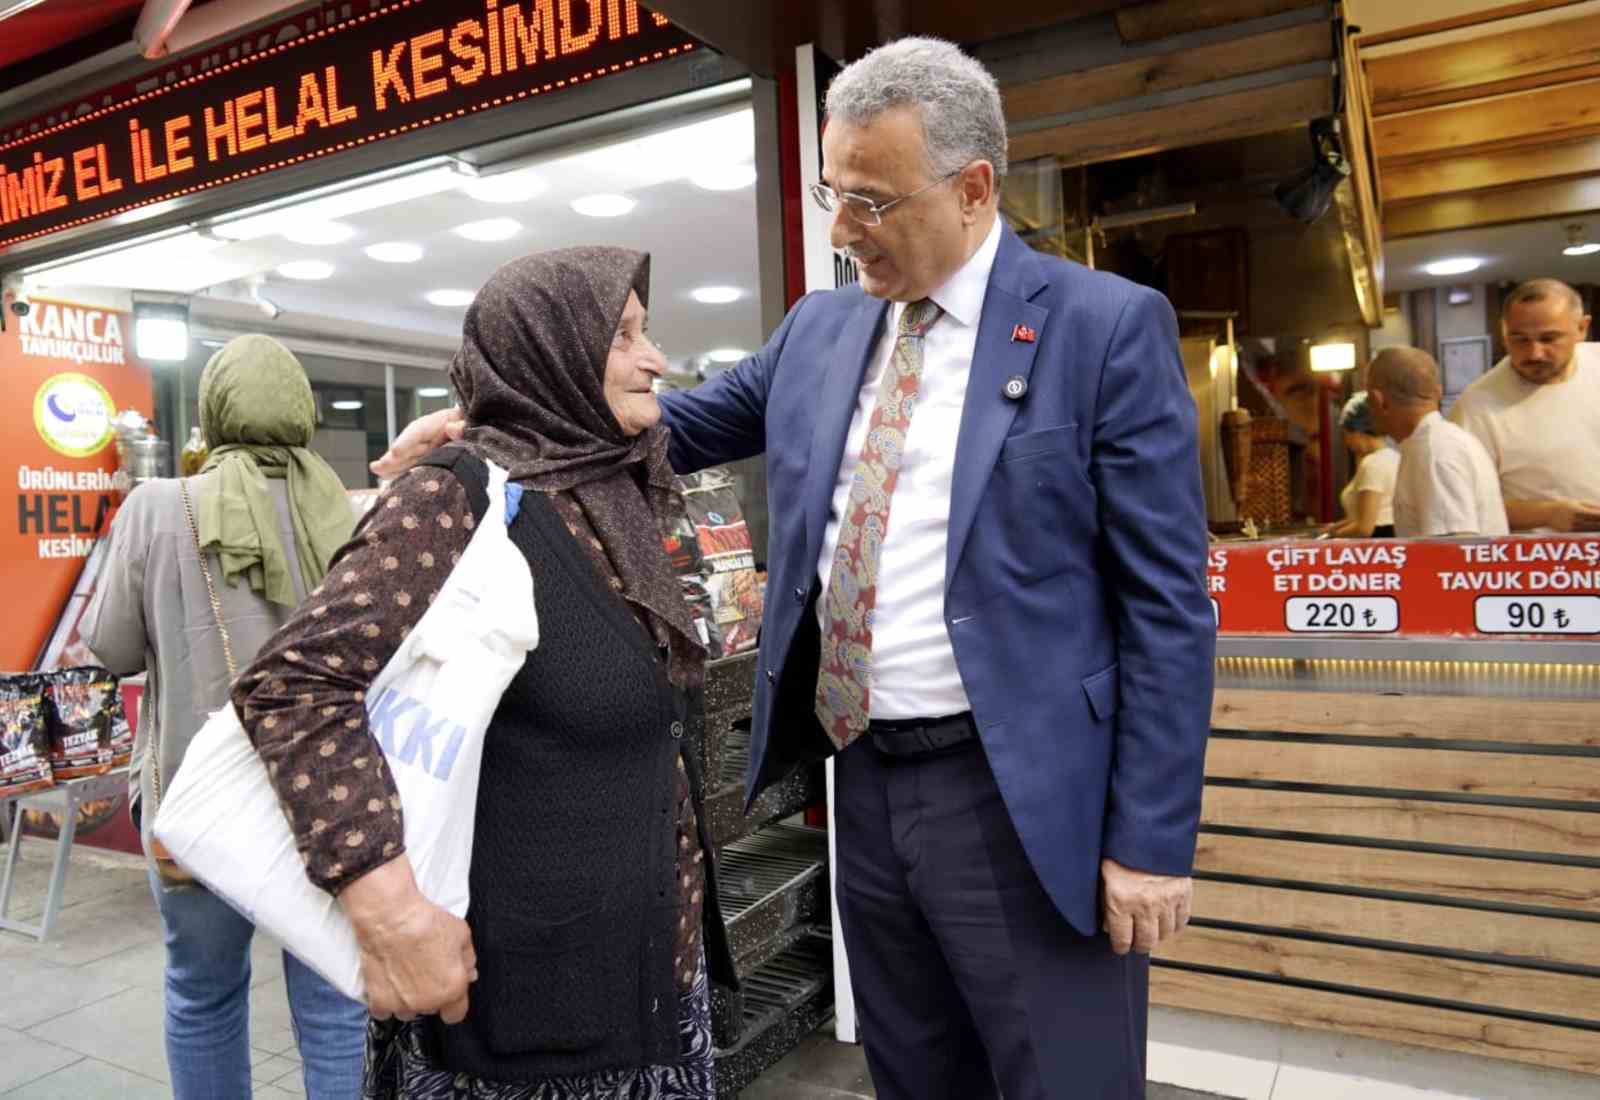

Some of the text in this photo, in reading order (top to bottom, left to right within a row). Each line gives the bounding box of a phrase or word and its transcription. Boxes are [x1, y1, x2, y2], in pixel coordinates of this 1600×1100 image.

[73, 144, 122, 201] EL
[129, 118, 195, 184] İLE
[204, 66, 358, 162] HELAL
[19, 302, 122, 345] KANCA
[1266, 545, 1407, 571] ÇİFT LAVAŞ
[1461, 542, 1600, 567] TEK LAVAŞ
[1273, 570, 1401, 592] ET DÖNER
[1437, 571, 1523, 590] TAVUK
[1305, 603, 1355, 627] 220
[1507, 602, 1545, 628] 90
